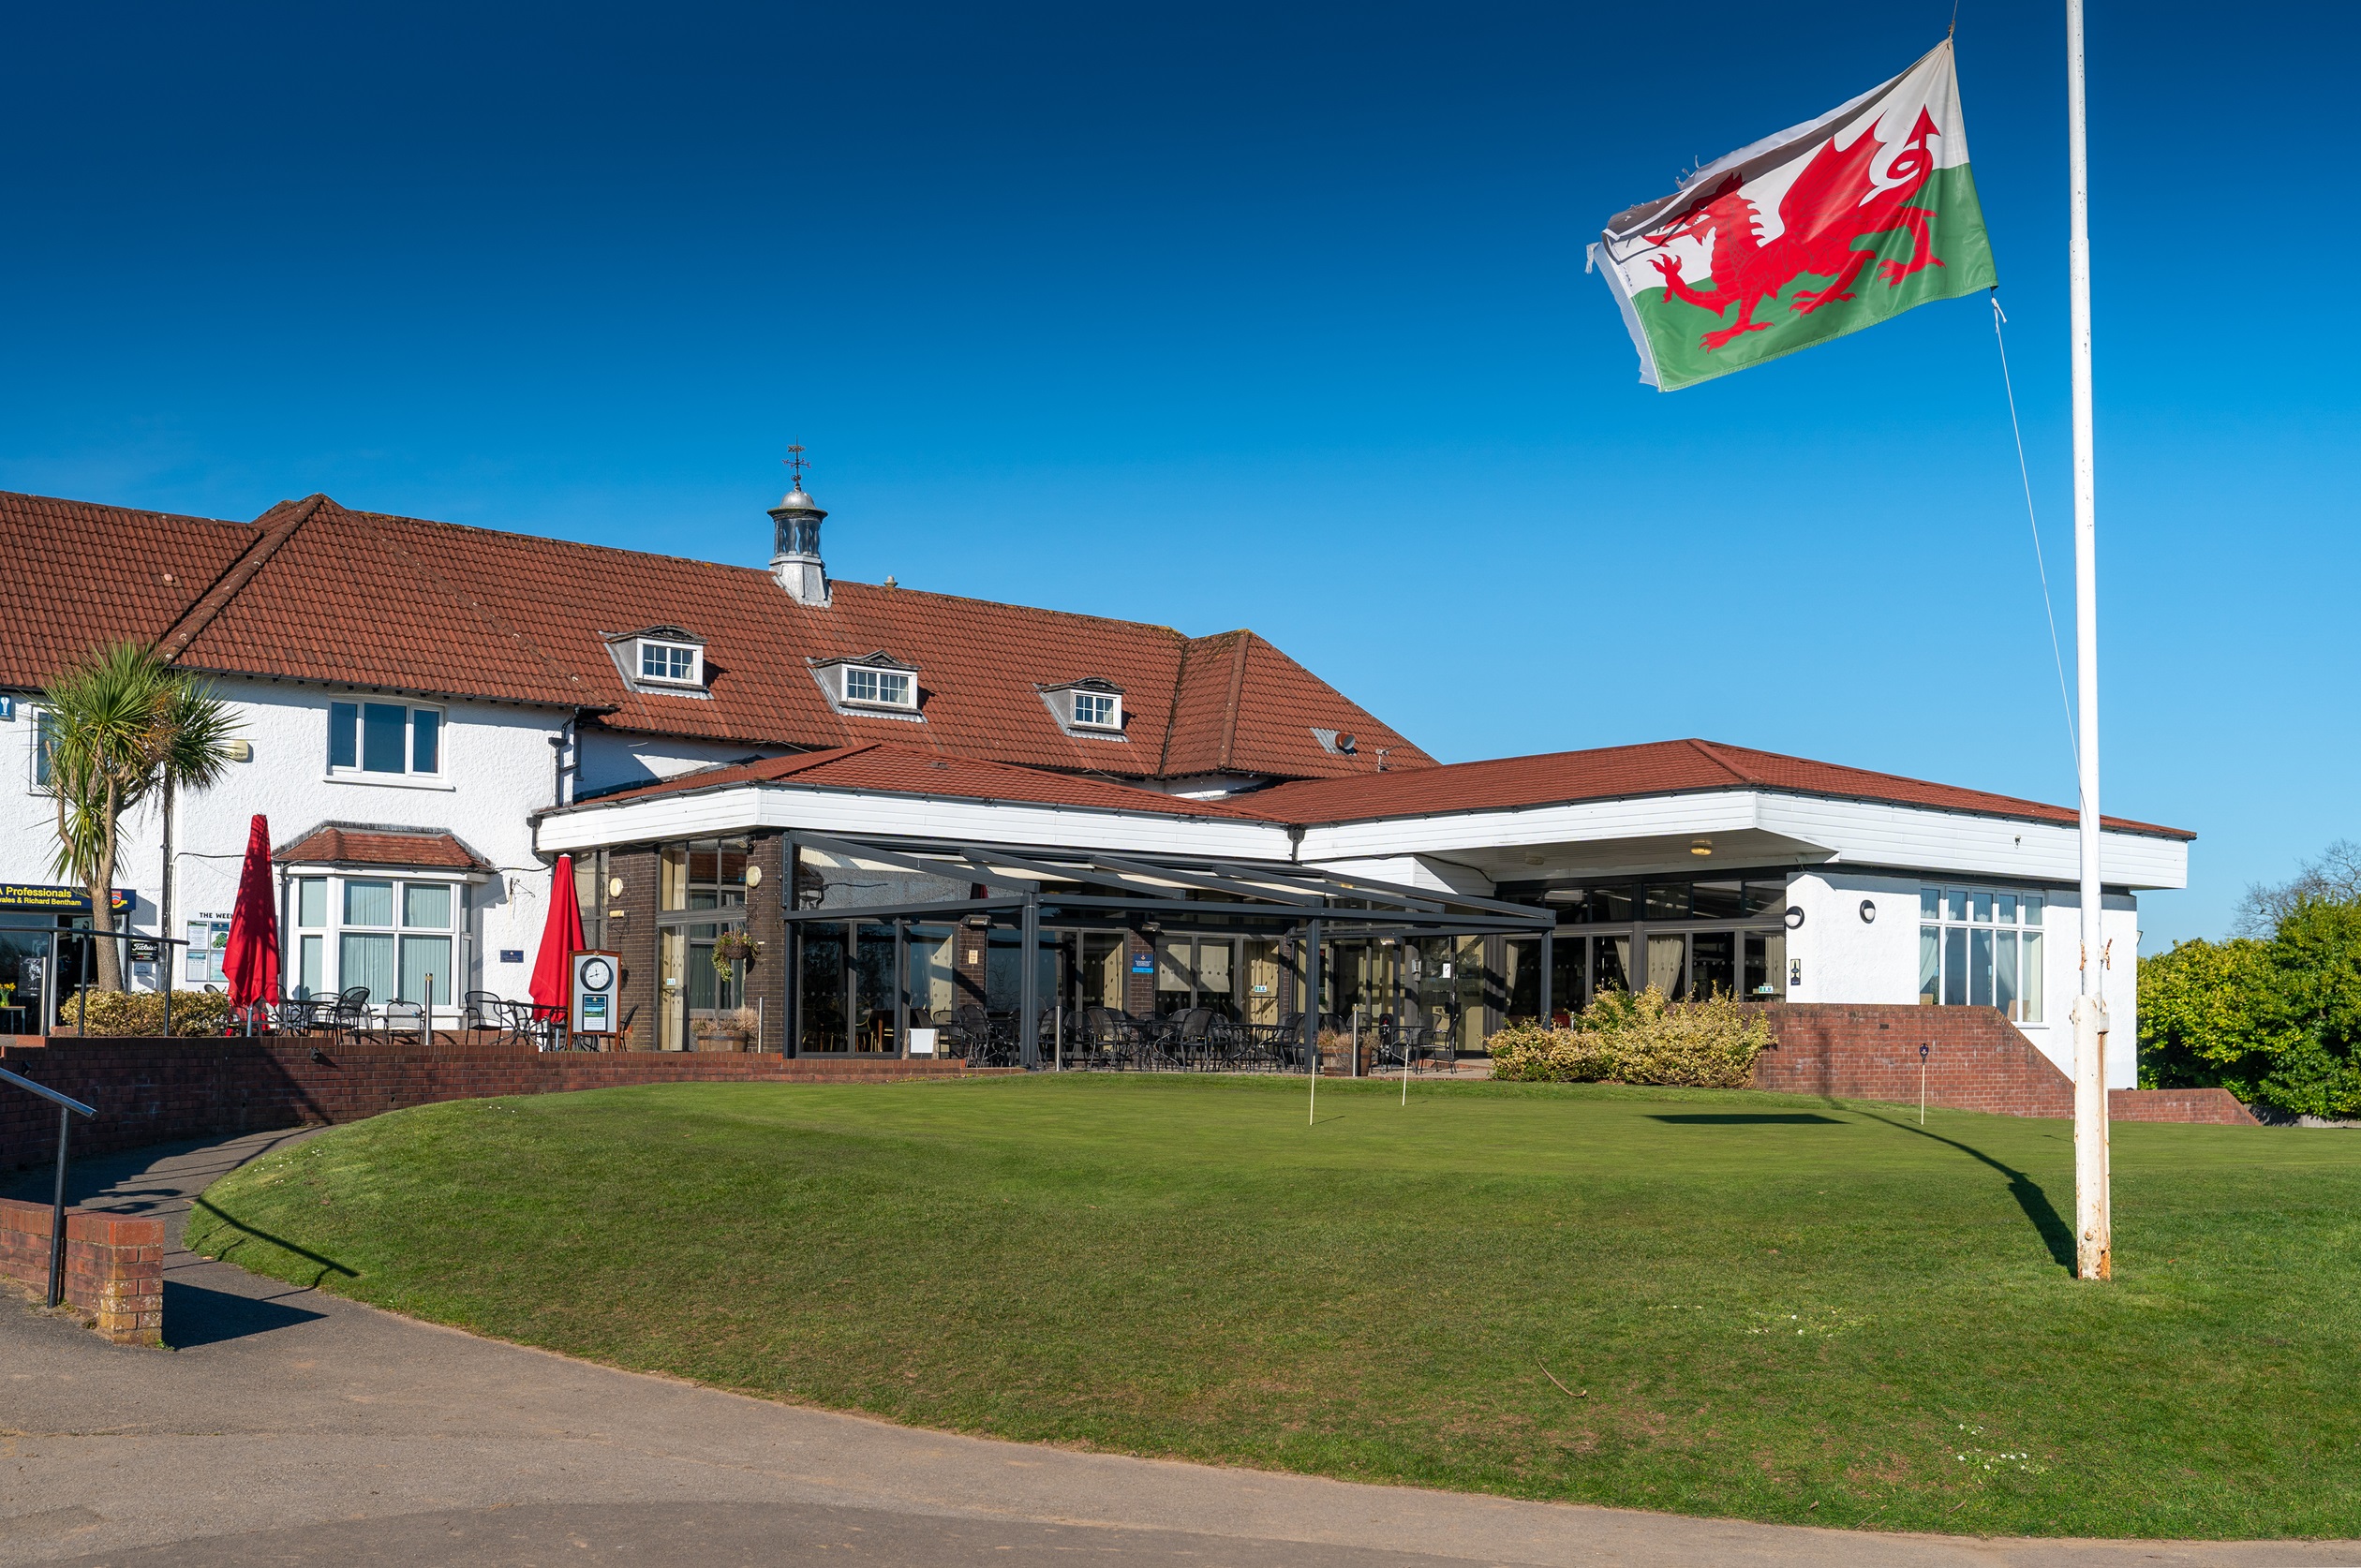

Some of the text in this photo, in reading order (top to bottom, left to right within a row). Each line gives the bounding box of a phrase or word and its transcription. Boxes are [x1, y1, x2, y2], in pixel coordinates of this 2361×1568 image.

[6, 886, 72, 898] Professionals
[23, 896, 51, 905] Richard
[51, 897, 82, 906] Bentham
